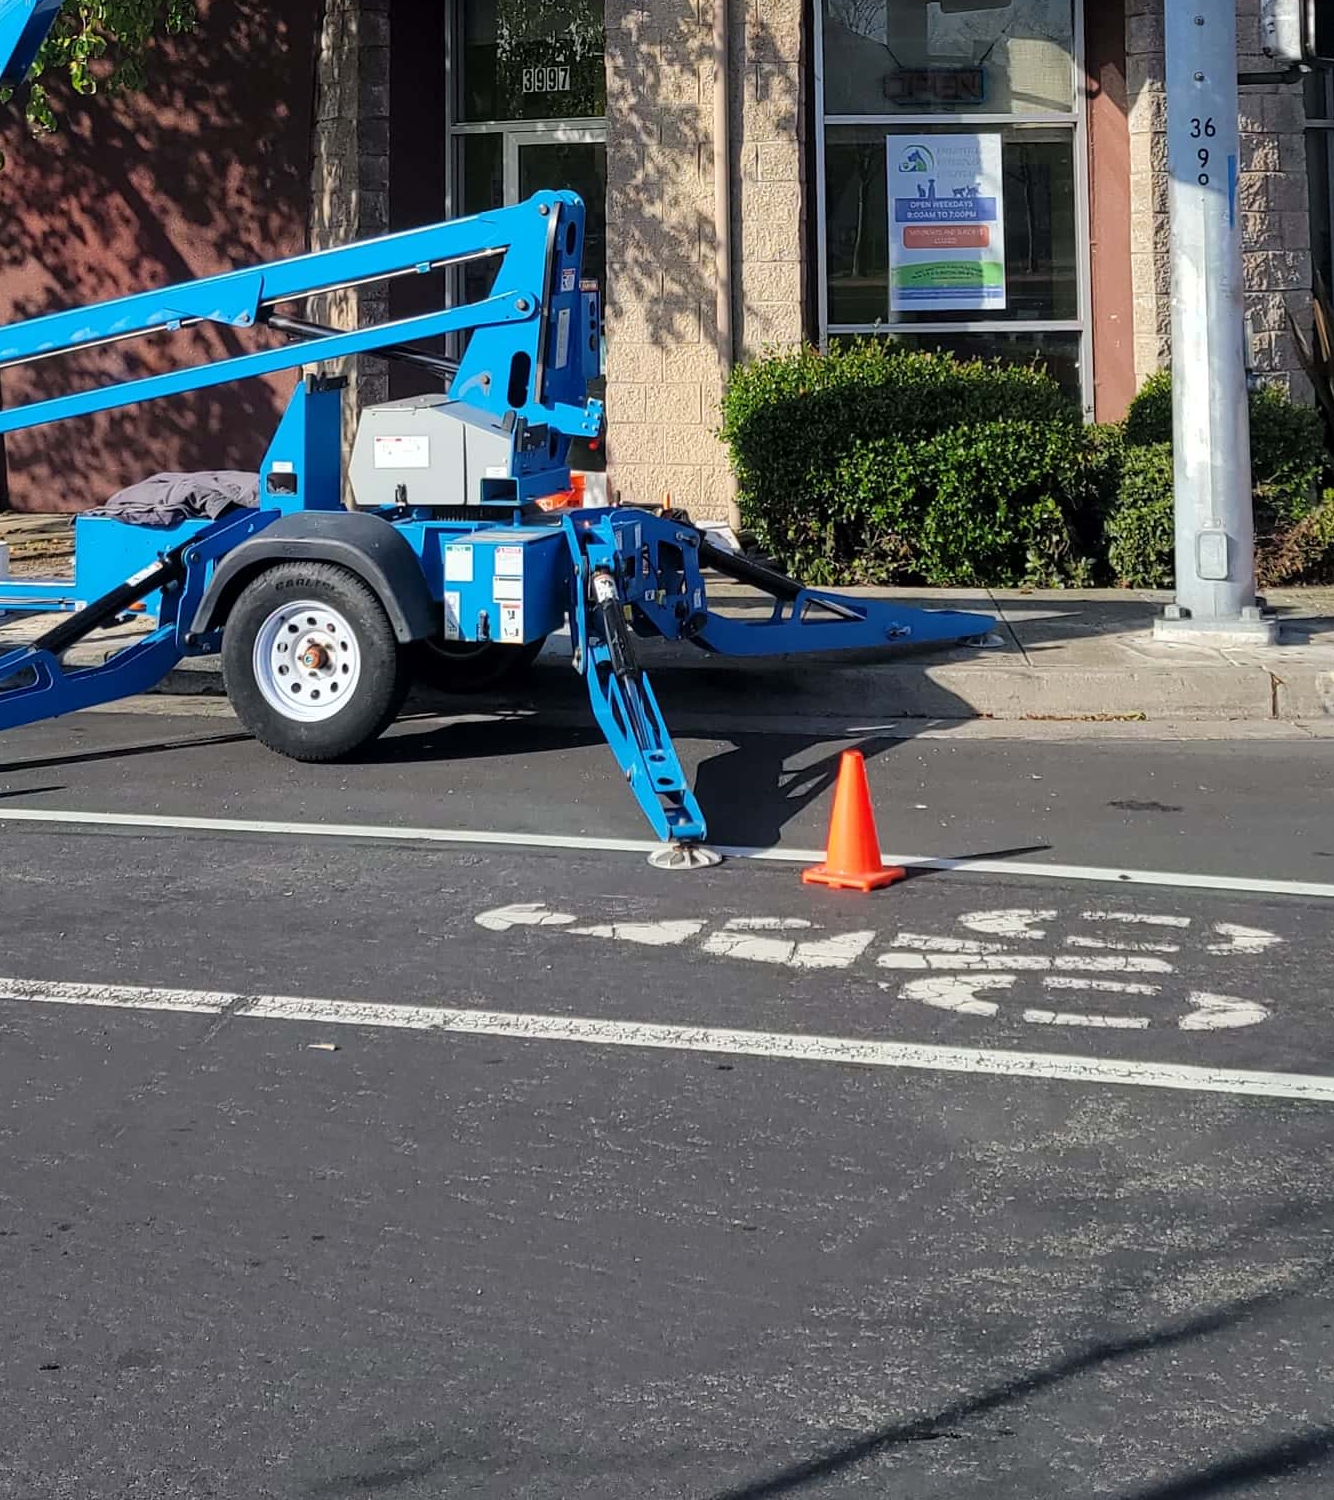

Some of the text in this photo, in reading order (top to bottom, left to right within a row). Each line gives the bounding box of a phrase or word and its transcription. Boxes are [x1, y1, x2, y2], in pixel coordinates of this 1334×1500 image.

[523, 67, 570, 92] 3997
[883, 73, 979, 100] OPEN
[1190, 117, 1216, 138] 36
